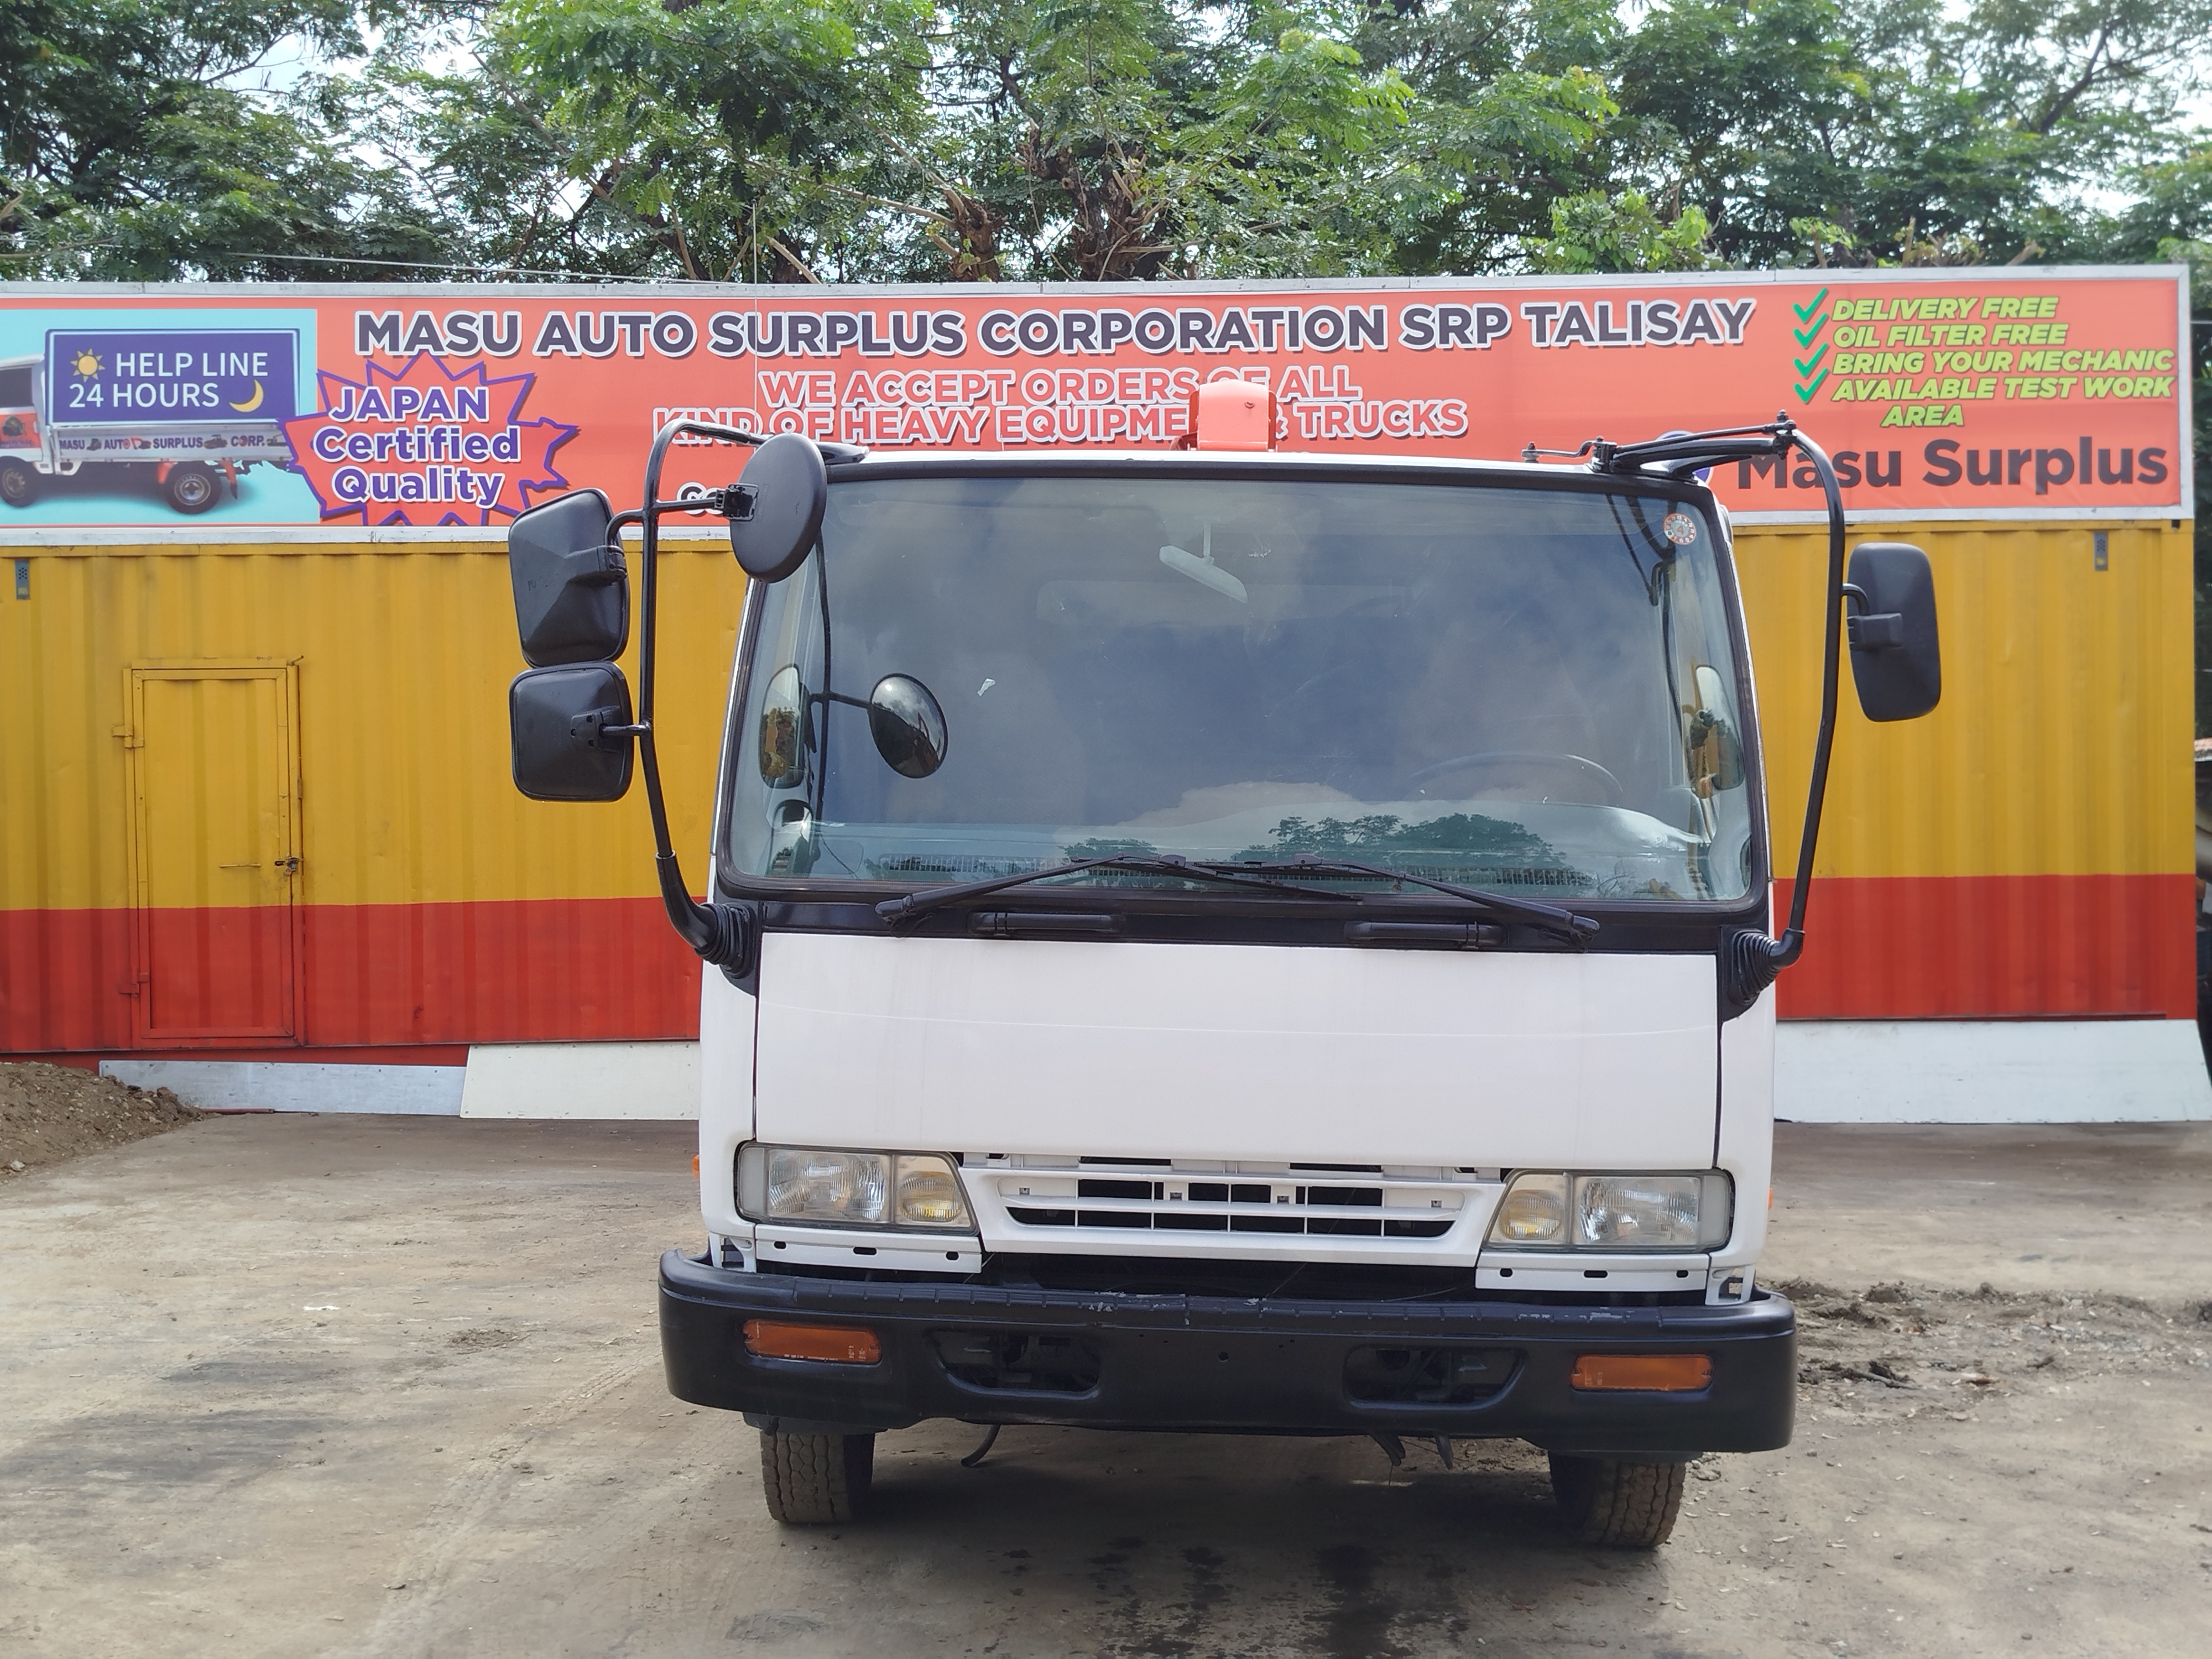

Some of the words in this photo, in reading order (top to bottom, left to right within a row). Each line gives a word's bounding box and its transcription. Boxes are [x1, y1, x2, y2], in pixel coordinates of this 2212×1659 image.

[1832, 297, 1979, 321] DELIVERY
[1981, 296, 2059, 319] FREE
[355, 310, 522, 357] MASU
[533, 310, 697, 357] AUTO
[708, 310, 967, 357] SURPLUS
[977, 305, 1387, 356] CORPORATION
[1399, 302, 1511, 349] SRP
[1521, 298, 1756, 348] TALISAY
[1833, 326, 1880, 348] OIL
[1887, 324, 1989, 347] FILTER
[1990, 324, 2069, 345] FREE
[116, 353, 193, 377] HELP
[202, 352, 268, 377] LINE
[1832, 352, 1925, 375] BRING
[1932, 351, 2014, 374] YOUR
[2017, 349, 2175, 372] MECHANIC
[70, 383, 104, 408] 24
[113, 382, 219, 408] HOURS
[758, 371, 836, 408] WE
[842, 369, 1015, 408] ACCEPT
[1021, 367, 1199, 406] ORDERS
[1277, 365, 1363, 403] ALL
[1831, 377, 1997, 401] AVAILABLE
[2005, 376, 2077, 399] TEST
[2084, 375, 2177, 398] WORK
[329, 387, 489, 422] JAPAN
[1880, 404, 1964, 427] AREA
[769, 406, 834, 441] OF
[842, 406, 990, 444] HEAVY
[996, 403, 1190, 444] EQUIPME
[1292, 399, 1469, 440] TRUCKS
[59, 440, 85, 451] MASU
[153, 437, 203, 449] SURPLUS
[313, 425, 520, 463] Certified
[1738, 449, 1901, 489] Masu
[1922, 436, 2168, 495] Surplus
[332, 465, 505, 508] Quality
